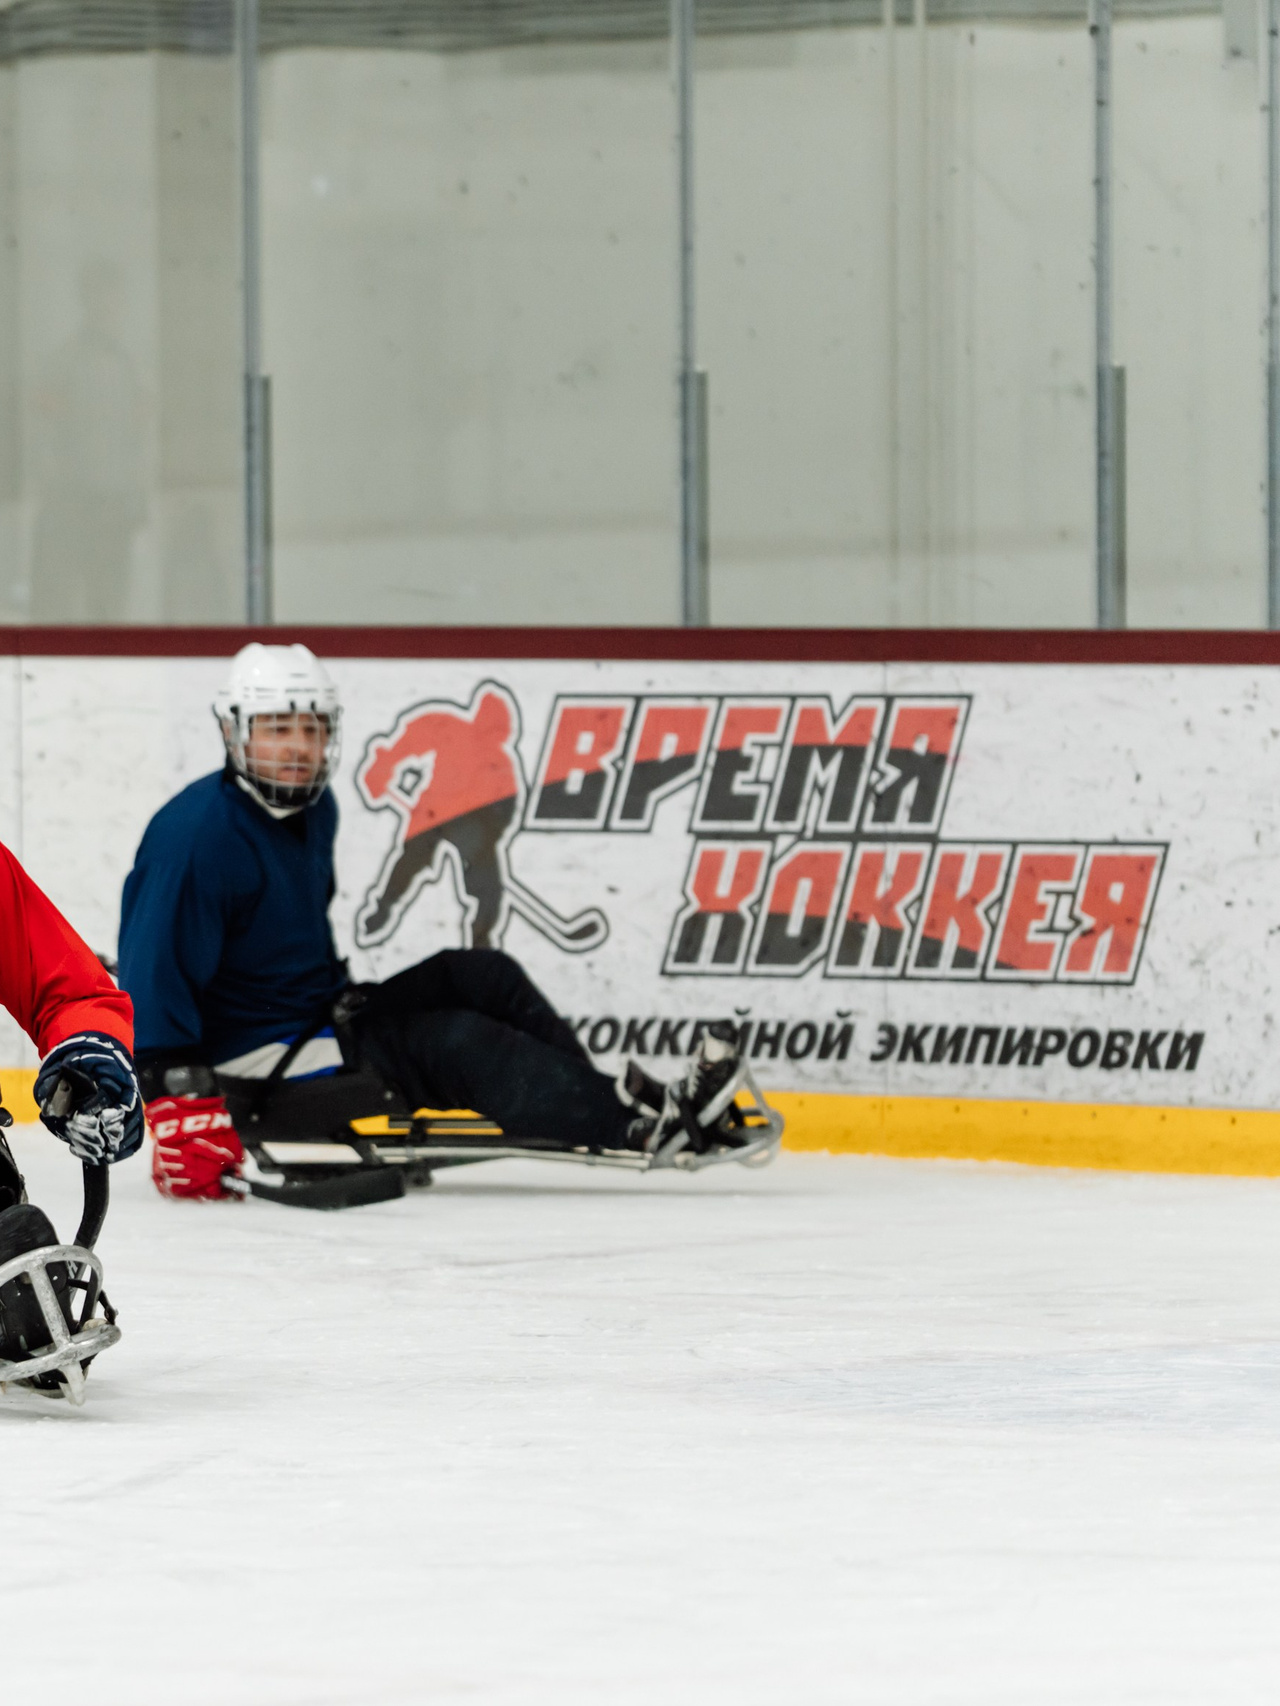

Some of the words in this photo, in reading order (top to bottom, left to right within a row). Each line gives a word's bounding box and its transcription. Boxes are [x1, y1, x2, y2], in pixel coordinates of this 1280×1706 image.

[523, 693, 973, 833] ВРЕМЯ
[661, 841, 1170, 985] ХОККЕЯ
[869, 1021, 1206, 1072] ЭКИПИРОВКИ
